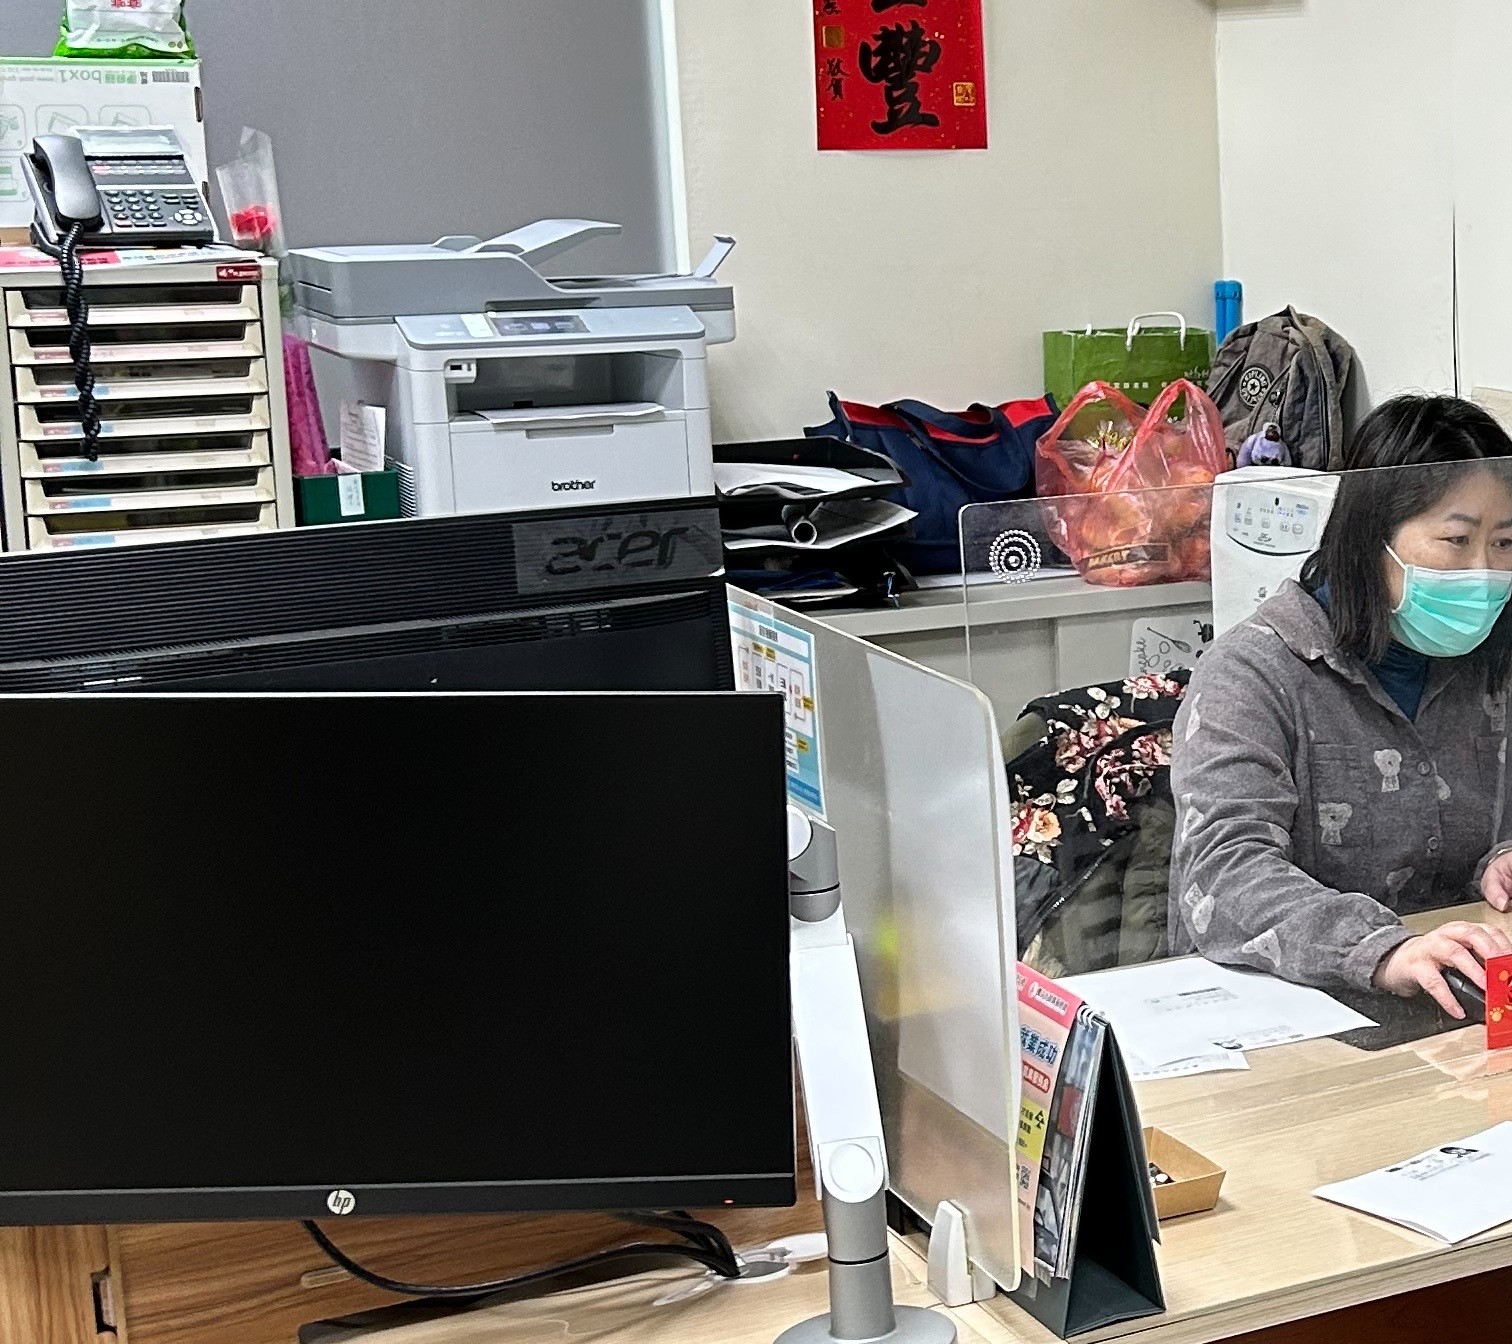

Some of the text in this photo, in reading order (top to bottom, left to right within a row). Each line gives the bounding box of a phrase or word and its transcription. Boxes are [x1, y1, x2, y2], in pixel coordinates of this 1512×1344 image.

[552, 480, 596, 492] brother
[545, 527, 690, 575] acer
[329, 1189, 354, 1215] hp
